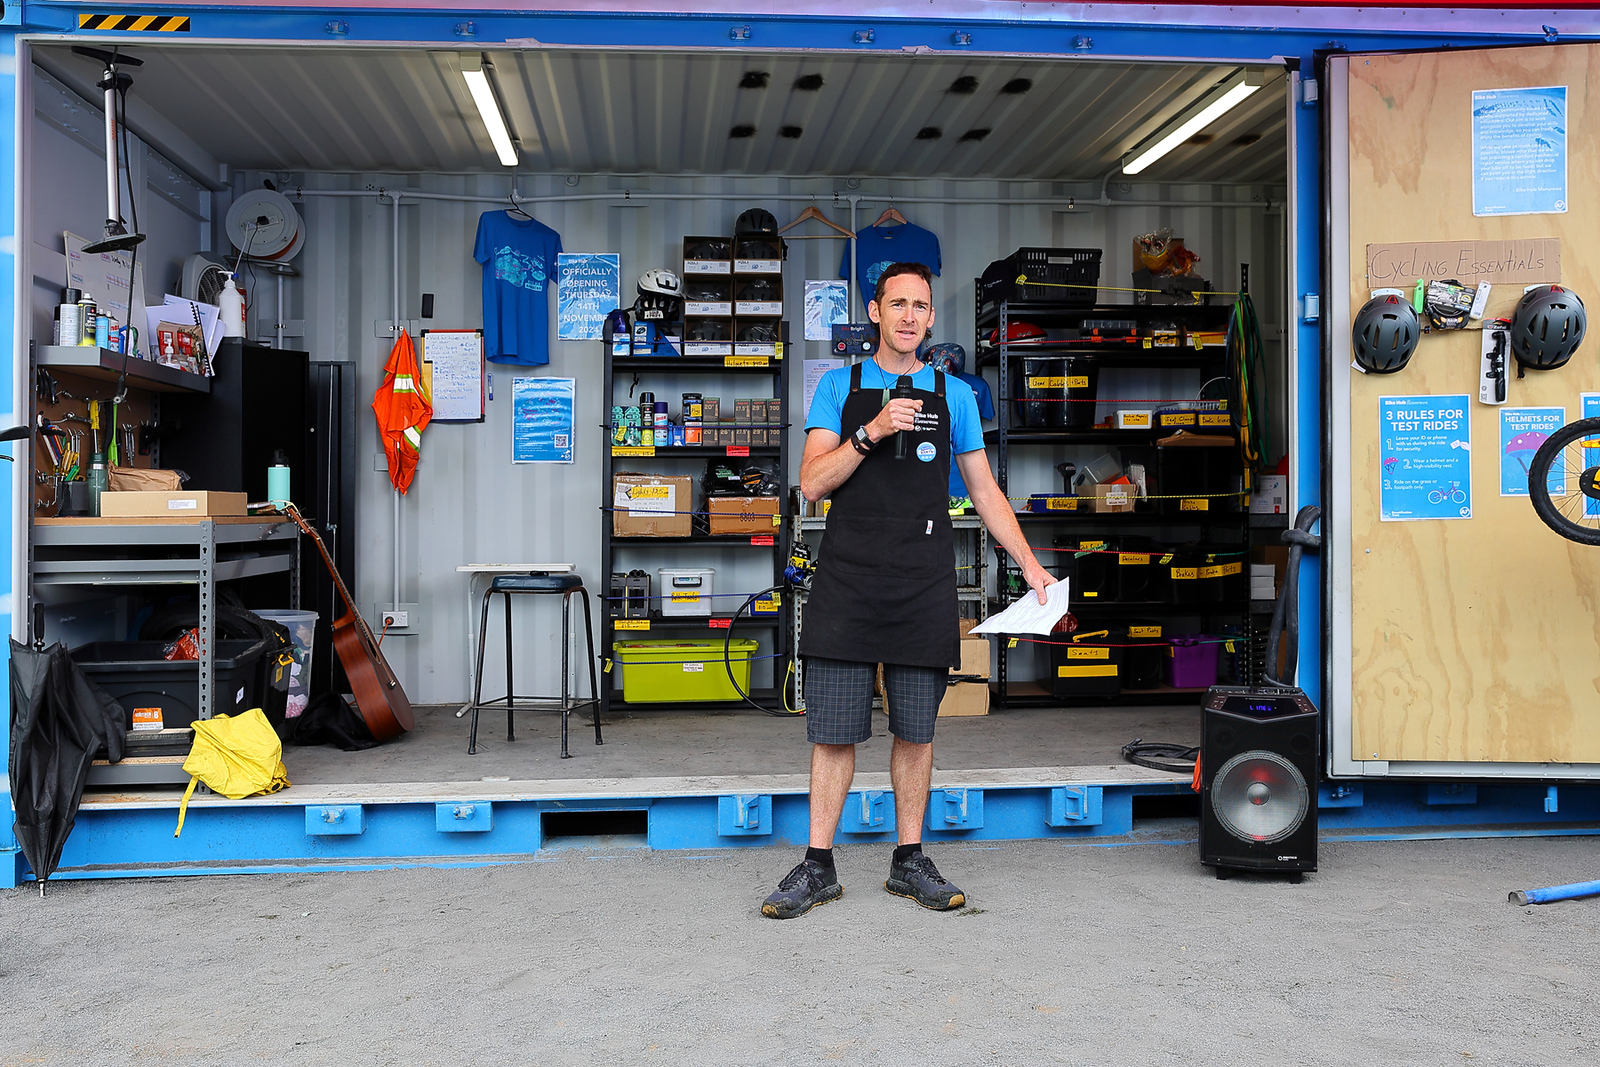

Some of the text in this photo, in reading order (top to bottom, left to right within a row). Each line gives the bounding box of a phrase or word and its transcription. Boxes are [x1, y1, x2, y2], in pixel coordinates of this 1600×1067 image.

[562, 268, 612, 276] OFFICIALLY
[565, 291, 612, 299] THURSDAY
[1386, 409, 1464, 420] 3 RULES FOR
[1390, 420, 1458, 431] TEST RIDES
